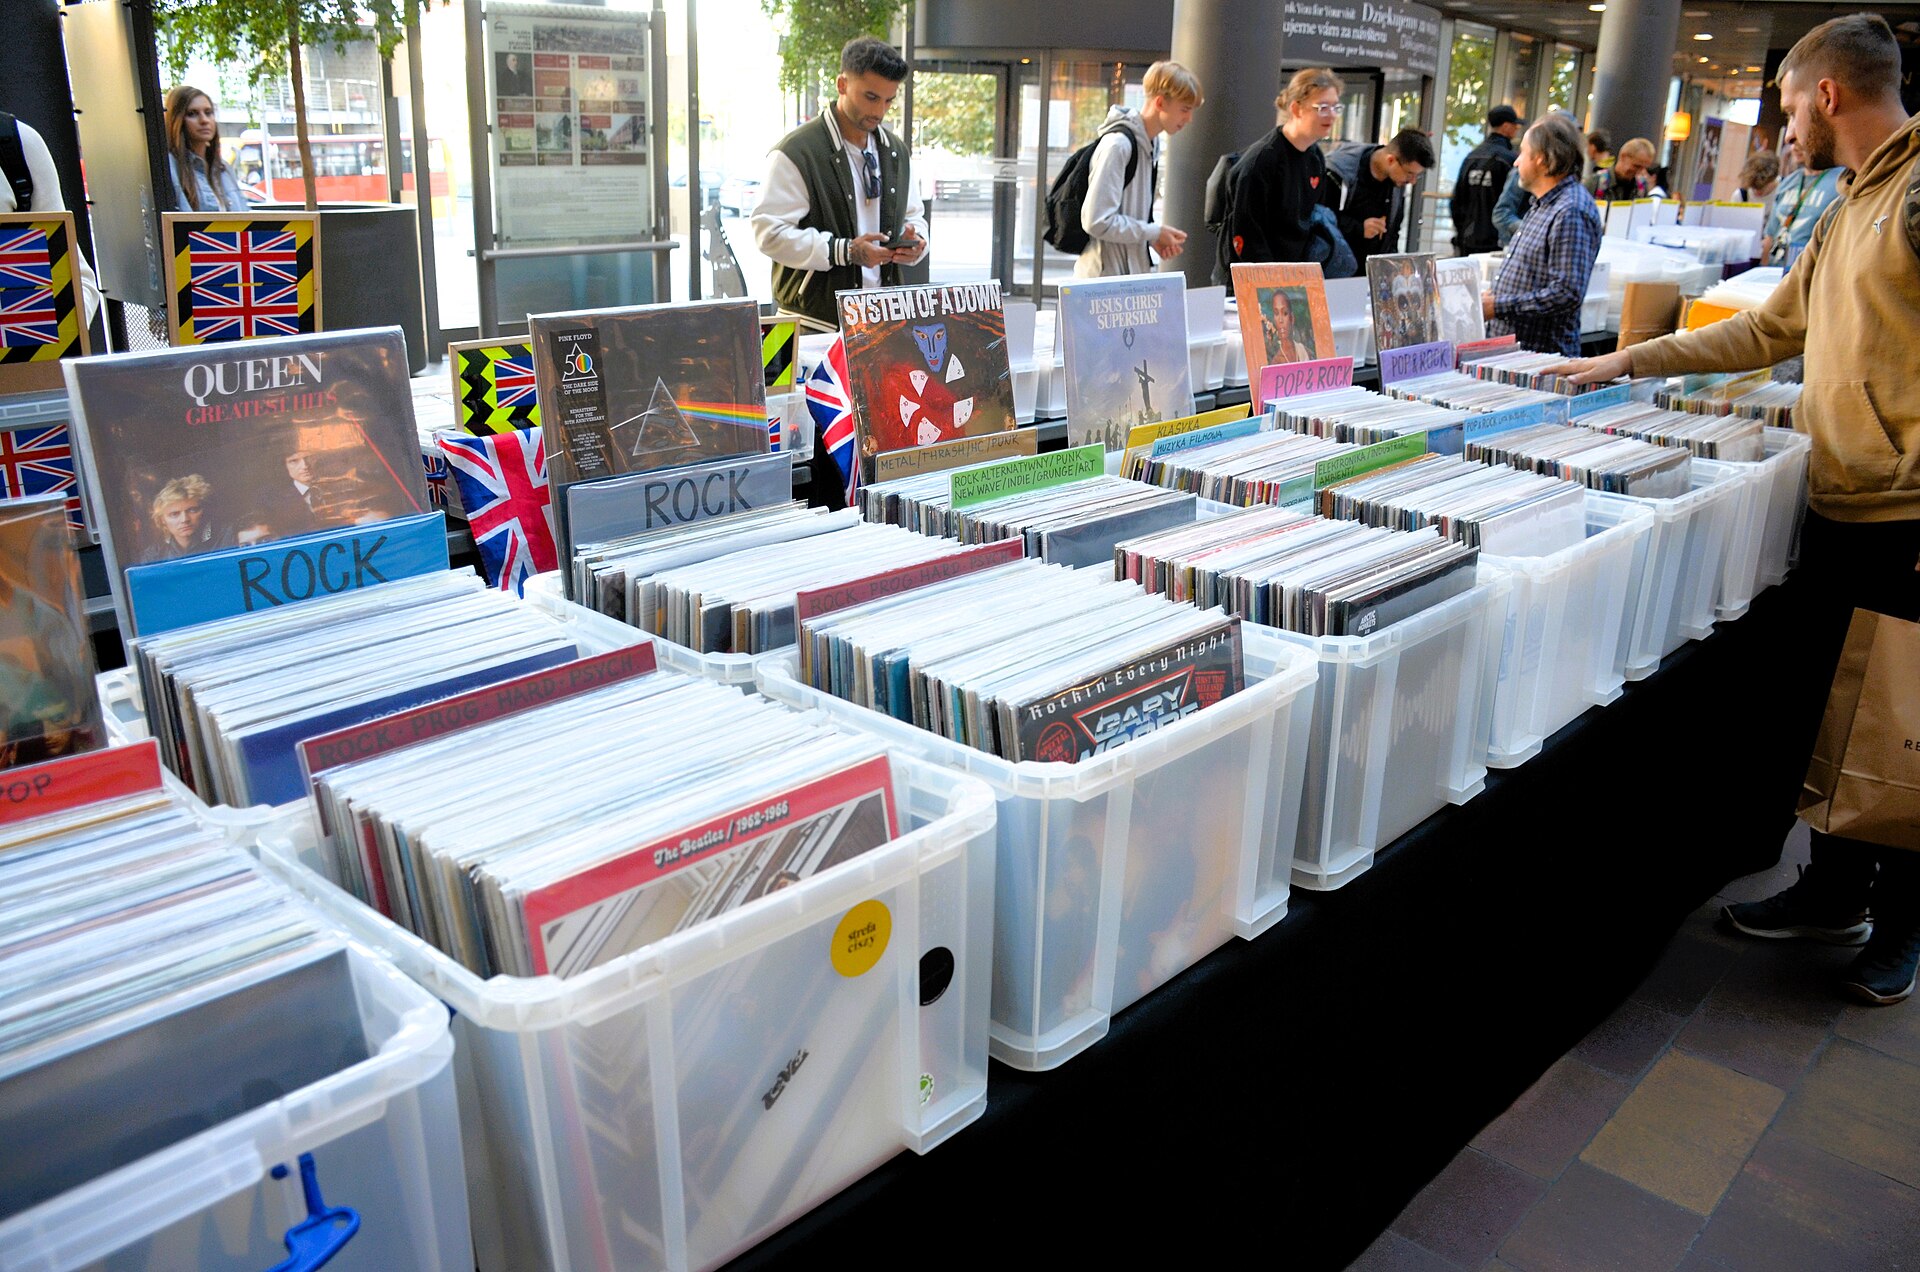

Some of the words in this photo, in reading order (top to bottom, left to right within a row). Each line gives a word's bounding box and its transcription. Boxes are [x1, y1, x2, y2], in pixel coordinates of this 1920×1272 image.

[843, 290, 916, 326] SYSTEM
[916, 289, 938, 318] OF
[941, 288, 954, 315] A
[952, 284, 1002, 314] DOWN
[1089, 297, 1122, 315] JESUS
[1124, 294, 1163, 312] CHRIST
[1097, 309, 1158, 330] SUPERSTAR
[573, 333, 592, 341] FLOYD
[184, 351, 324, 407] QUEEN
[1391, 354, 1408, 377] POP
[1419, 349, 1448, 372] ROCK
[1274, 369, 1303, 399] POP
[1306, 367, 1314, 390] &
[1317, 365, 1352, 390] ROCK
[186, 395, 290, 426] GREATEST
[292, 391, 337, 411] HITS
[1156, 419, 1200, 439] KLASYKA
[954, 472, 979, 488] ROCK
[955, 487, 975, 500] NEW
[644, 468, 752, 529] ROCK
[238, 535, 389, 612] ROCK
[810, 589, 857, 616] ROCK
[870, 575, 913, 595] PROG
[920, 562, 961, 583] HARD
[1115, 655, 1169, 686] Every
[1176, 632, 1226, 662] Night
[318, 725, 392, 769] ROCK
[411, 700, 479, 738] PROG
[499, 680, 556, 712] HARD
[1095, 685, 1182, 743] GARY
[0, 773, 51, 803] OP
[654, 846, 680, 869] The
[679, 828, 725, 857] Beatles
[736, 800, 789, 835] 1962-1966
[848, 921, 877, 941] strefa
[848, 935, 875, 953] ciszy
